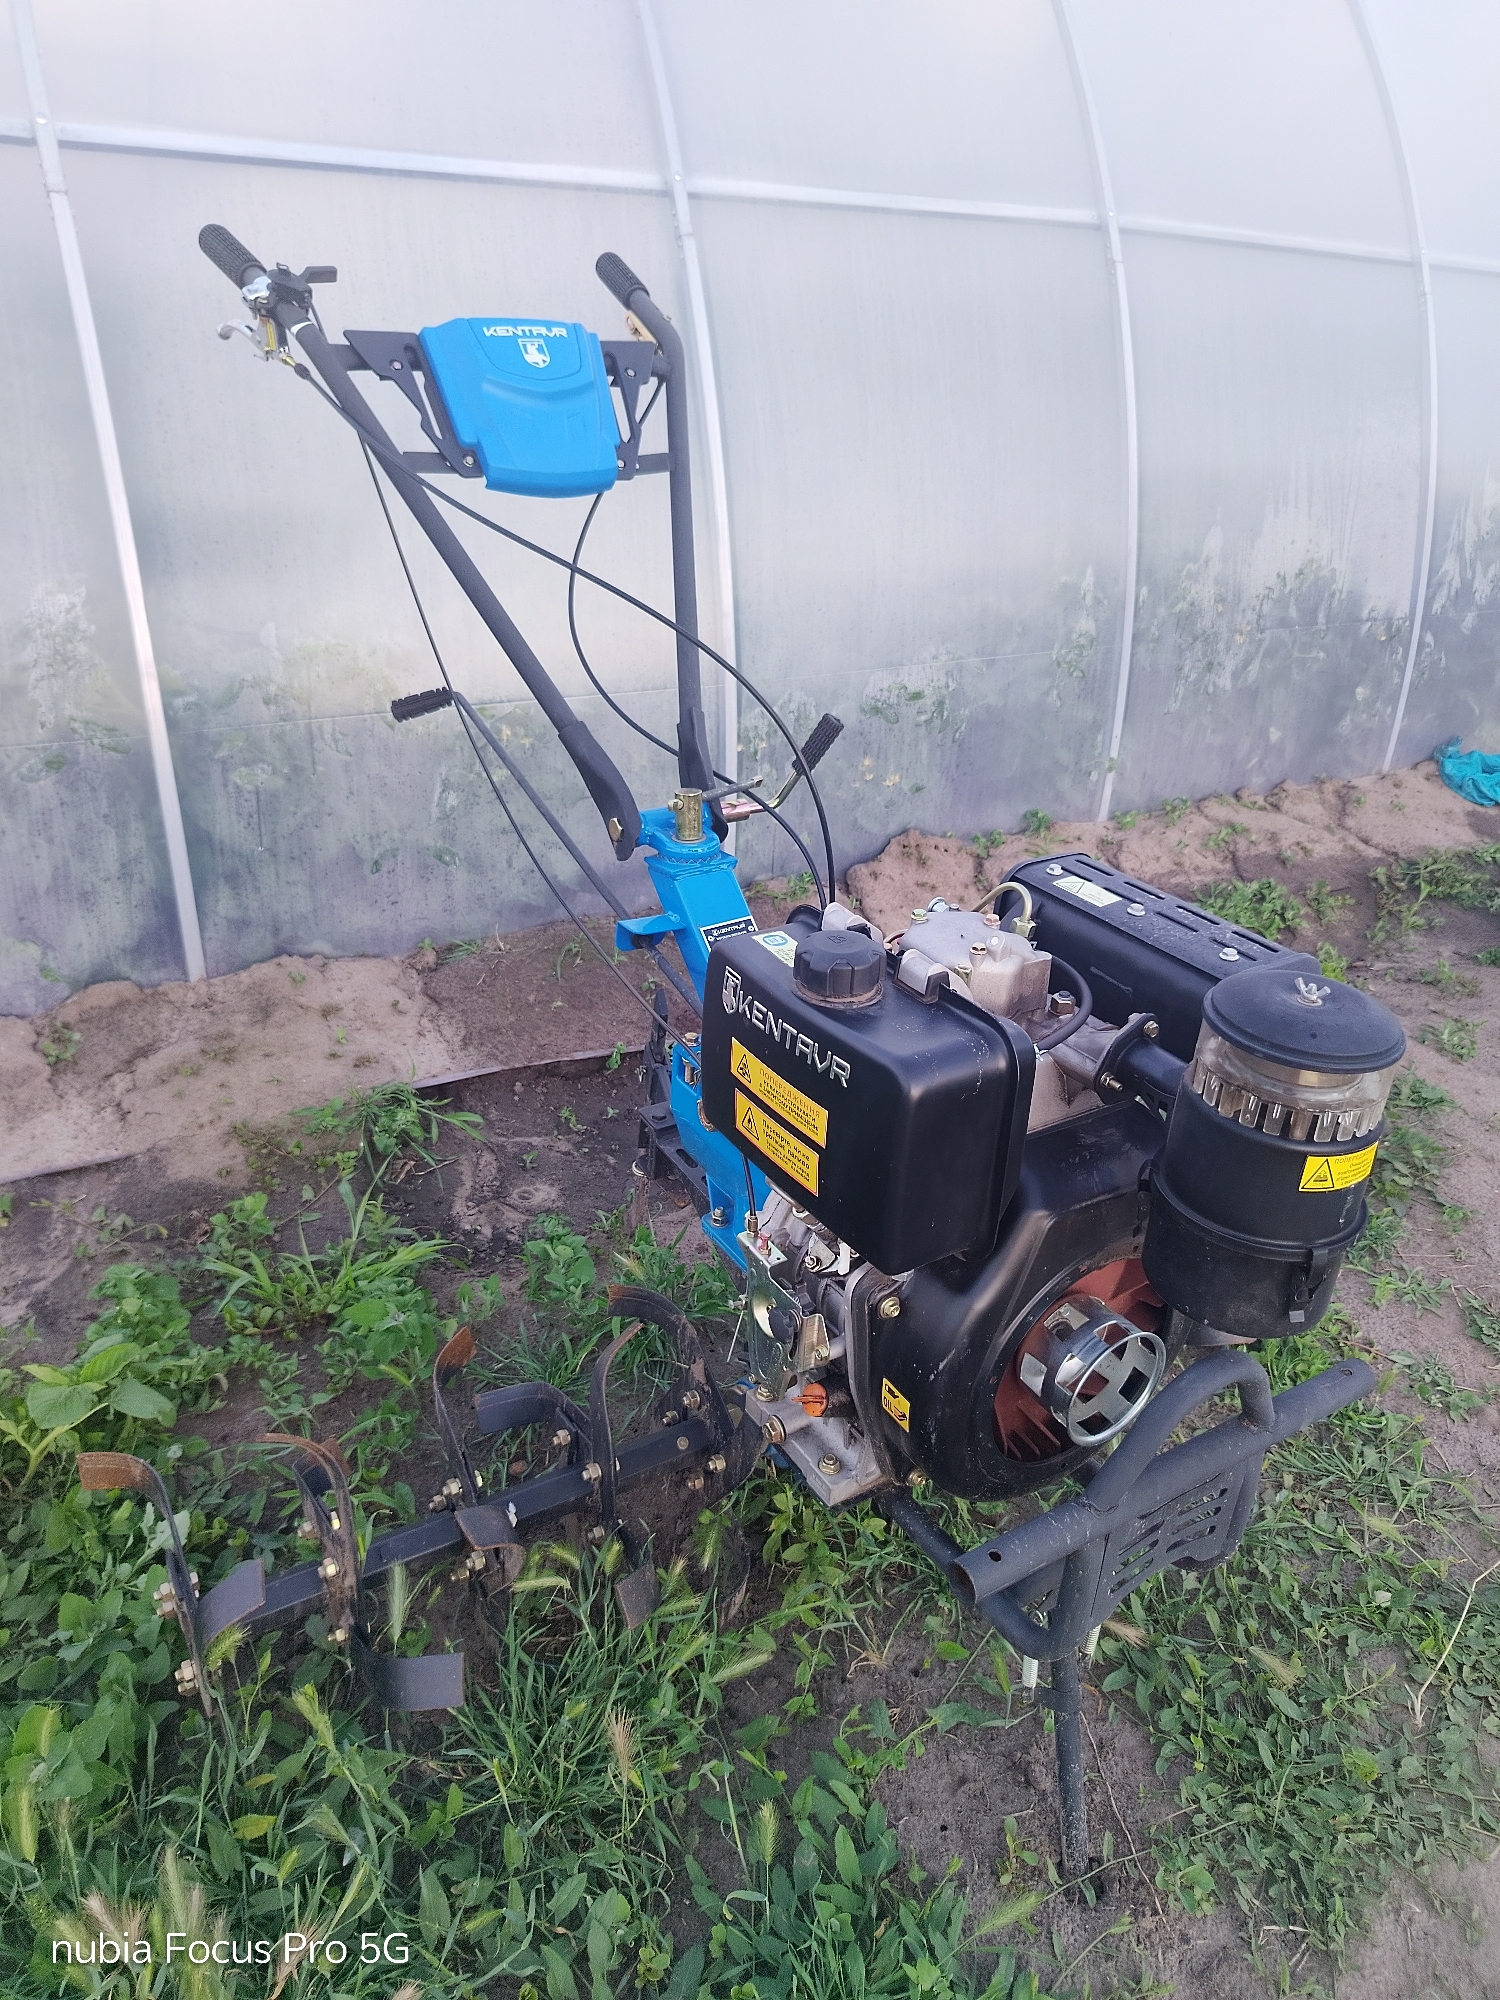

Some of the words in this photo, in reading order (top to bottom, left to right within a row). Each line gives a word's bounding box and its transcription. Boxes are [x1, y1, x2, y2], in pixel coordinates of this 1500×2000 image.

[483, 326, 568, 338] KENTAVR
[739, 991, 851, 1088] KENTAVR
[760, 1068, 820, 1118] ПОПЕРЕДЖЕННЯ
[883, 1396, 894, 1414] OIL
